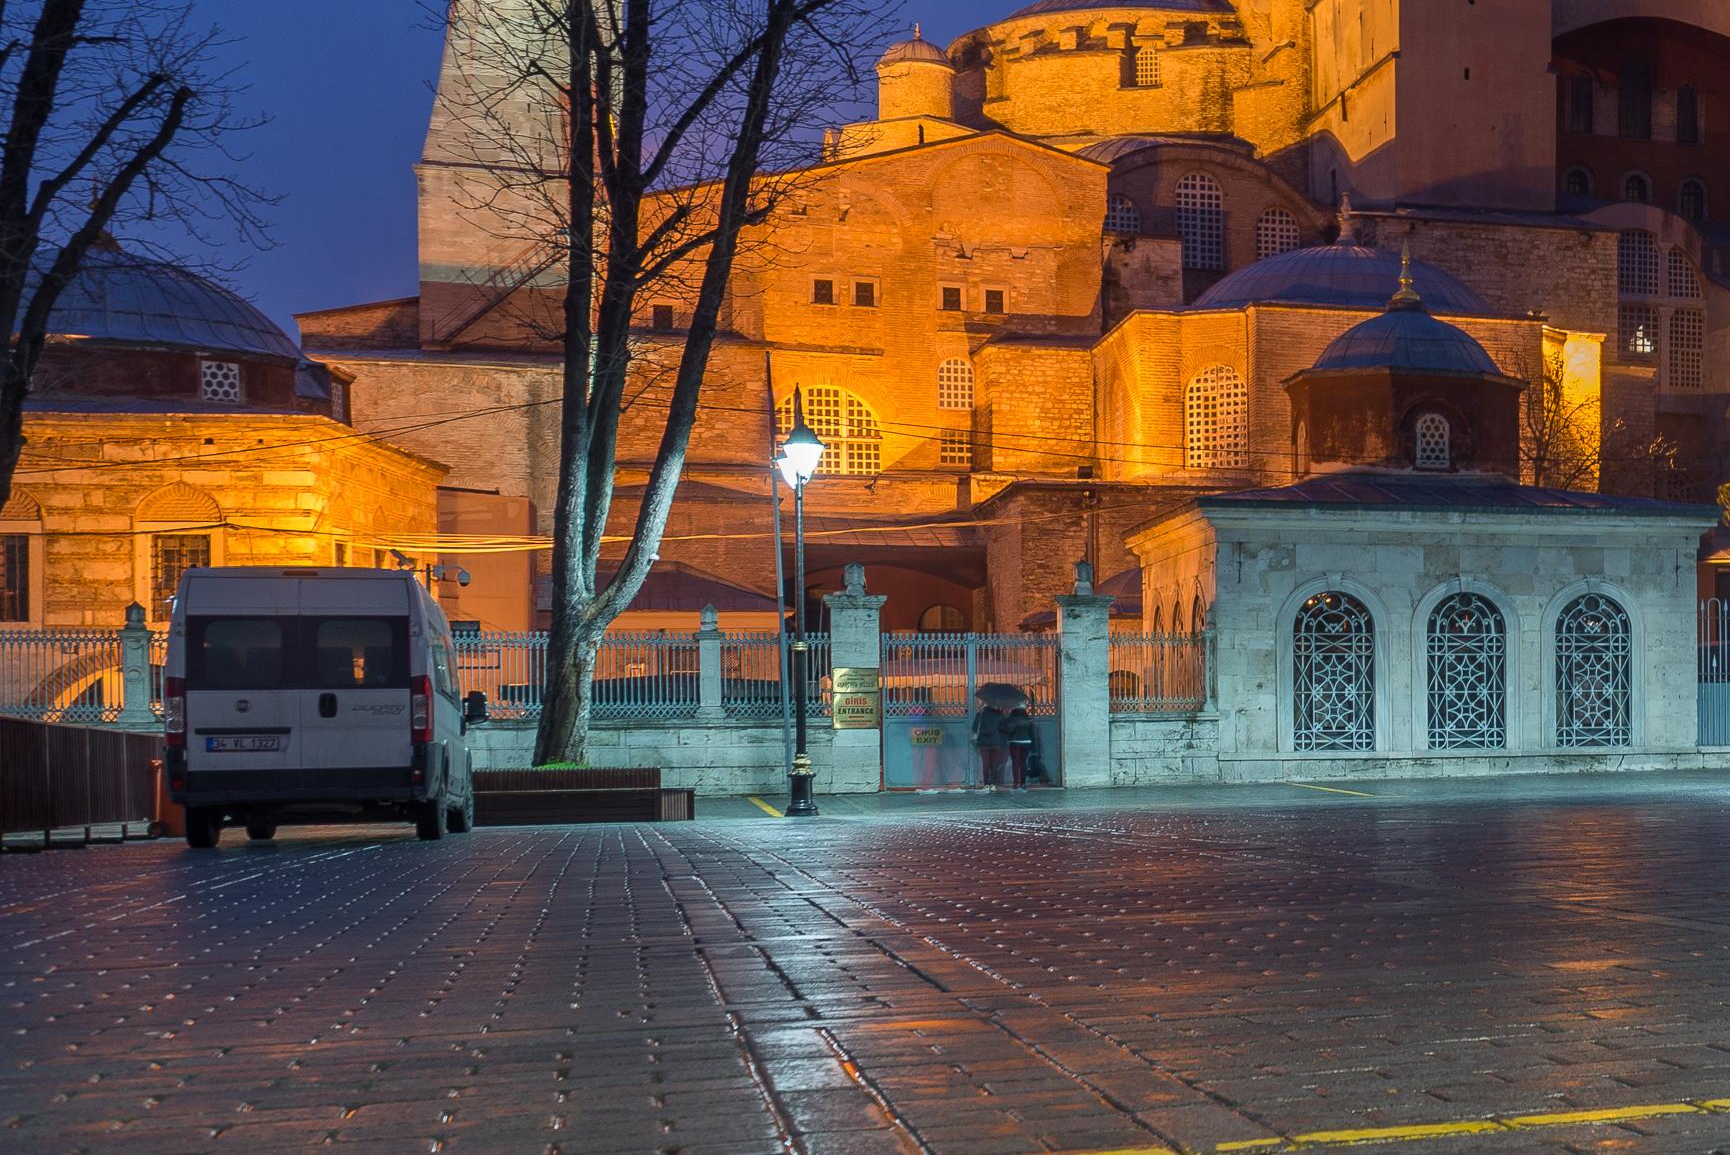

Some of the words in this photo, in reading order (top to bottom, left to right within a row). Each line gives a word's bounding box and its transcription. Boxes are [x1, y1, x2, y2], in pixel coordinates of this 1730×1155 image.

[214, 739, 226, 749] 34
[233, 739, 246, 749] VL
[251, 738, 276, 748] 1327
